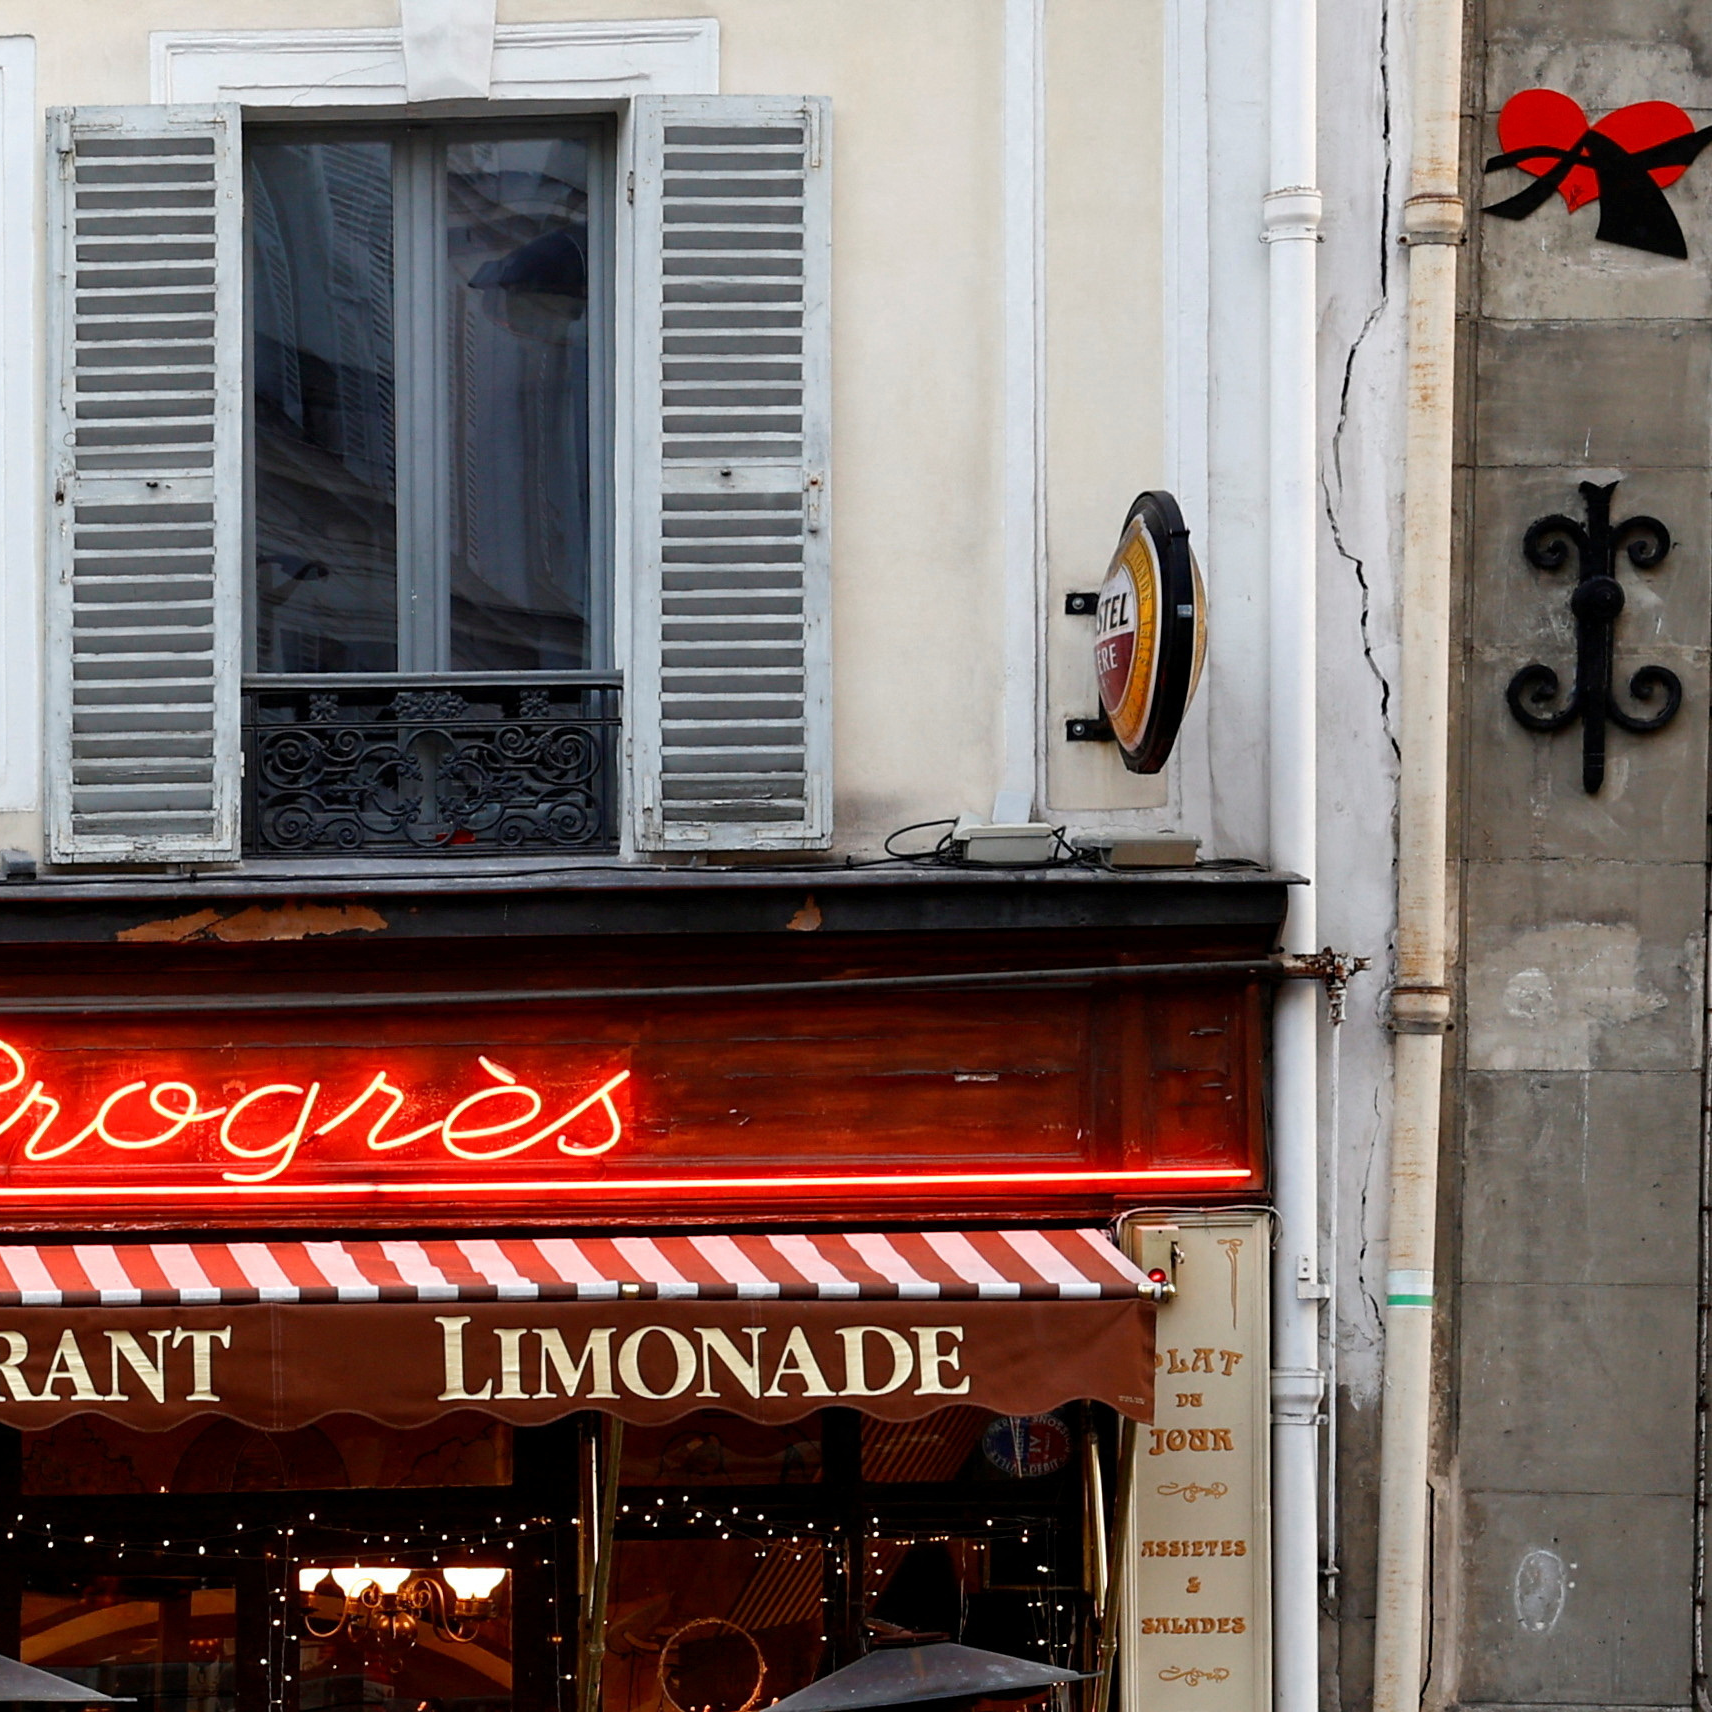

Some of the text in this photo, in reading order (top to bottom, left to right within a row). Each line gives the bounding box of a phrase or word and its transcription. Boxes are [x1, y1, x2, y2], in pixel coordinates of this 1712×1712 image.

[1097, 592, 1130, 634] STEL
[434, 1315, 971, 1402] LIMONADE
[1175, 1392, 1204, 1408] DU
[1148, 1427, 1235, 1456] JOUR
[1185, 1576, 1202, 1594] &
[1141, 1616, 1247, 1635] SALADES
